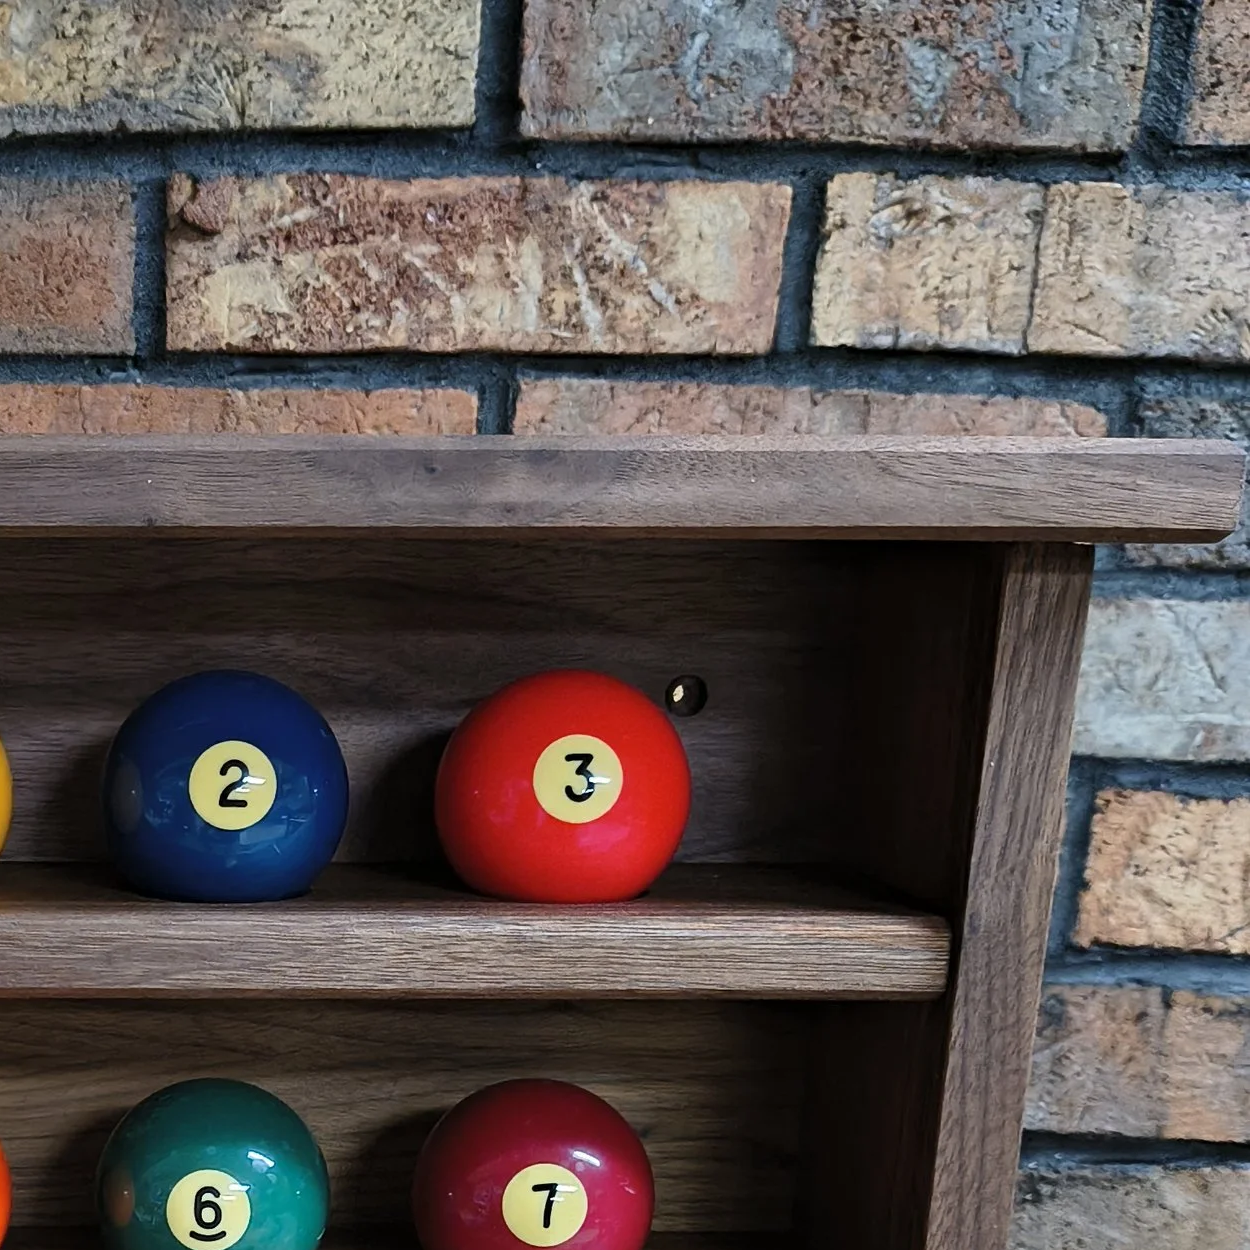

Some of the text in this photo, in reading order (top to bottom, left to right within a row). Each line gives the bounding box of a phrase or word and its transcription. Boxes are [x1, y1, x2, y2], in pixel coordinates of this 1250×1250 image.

[218, 758, 250, 808] 2
[564, 752, 596, 803] 3
[188, 1185, 227, 1243] 6
[531, 1182, 559, 1229] 7
